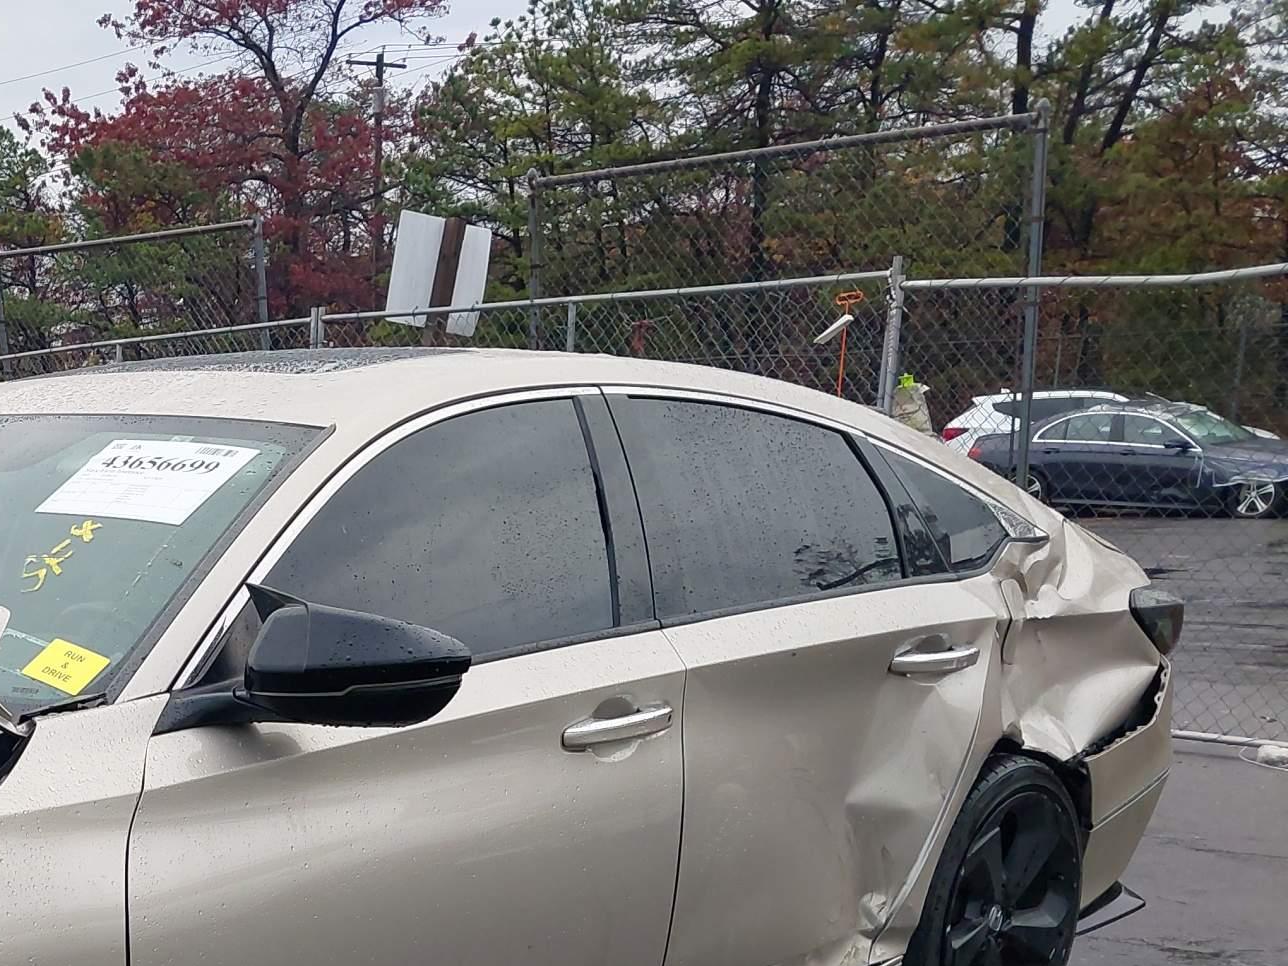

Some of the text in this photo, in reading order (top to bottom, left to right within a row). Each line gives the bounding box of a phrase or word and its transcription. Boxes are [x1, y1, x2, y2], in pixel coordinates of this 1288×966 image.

[101, 454, 221, 475] 43656699
[63, 650, 86, 663] RUN
[60, 662, 70, 670] &
[41, 666, 73, 683] DRIVE
